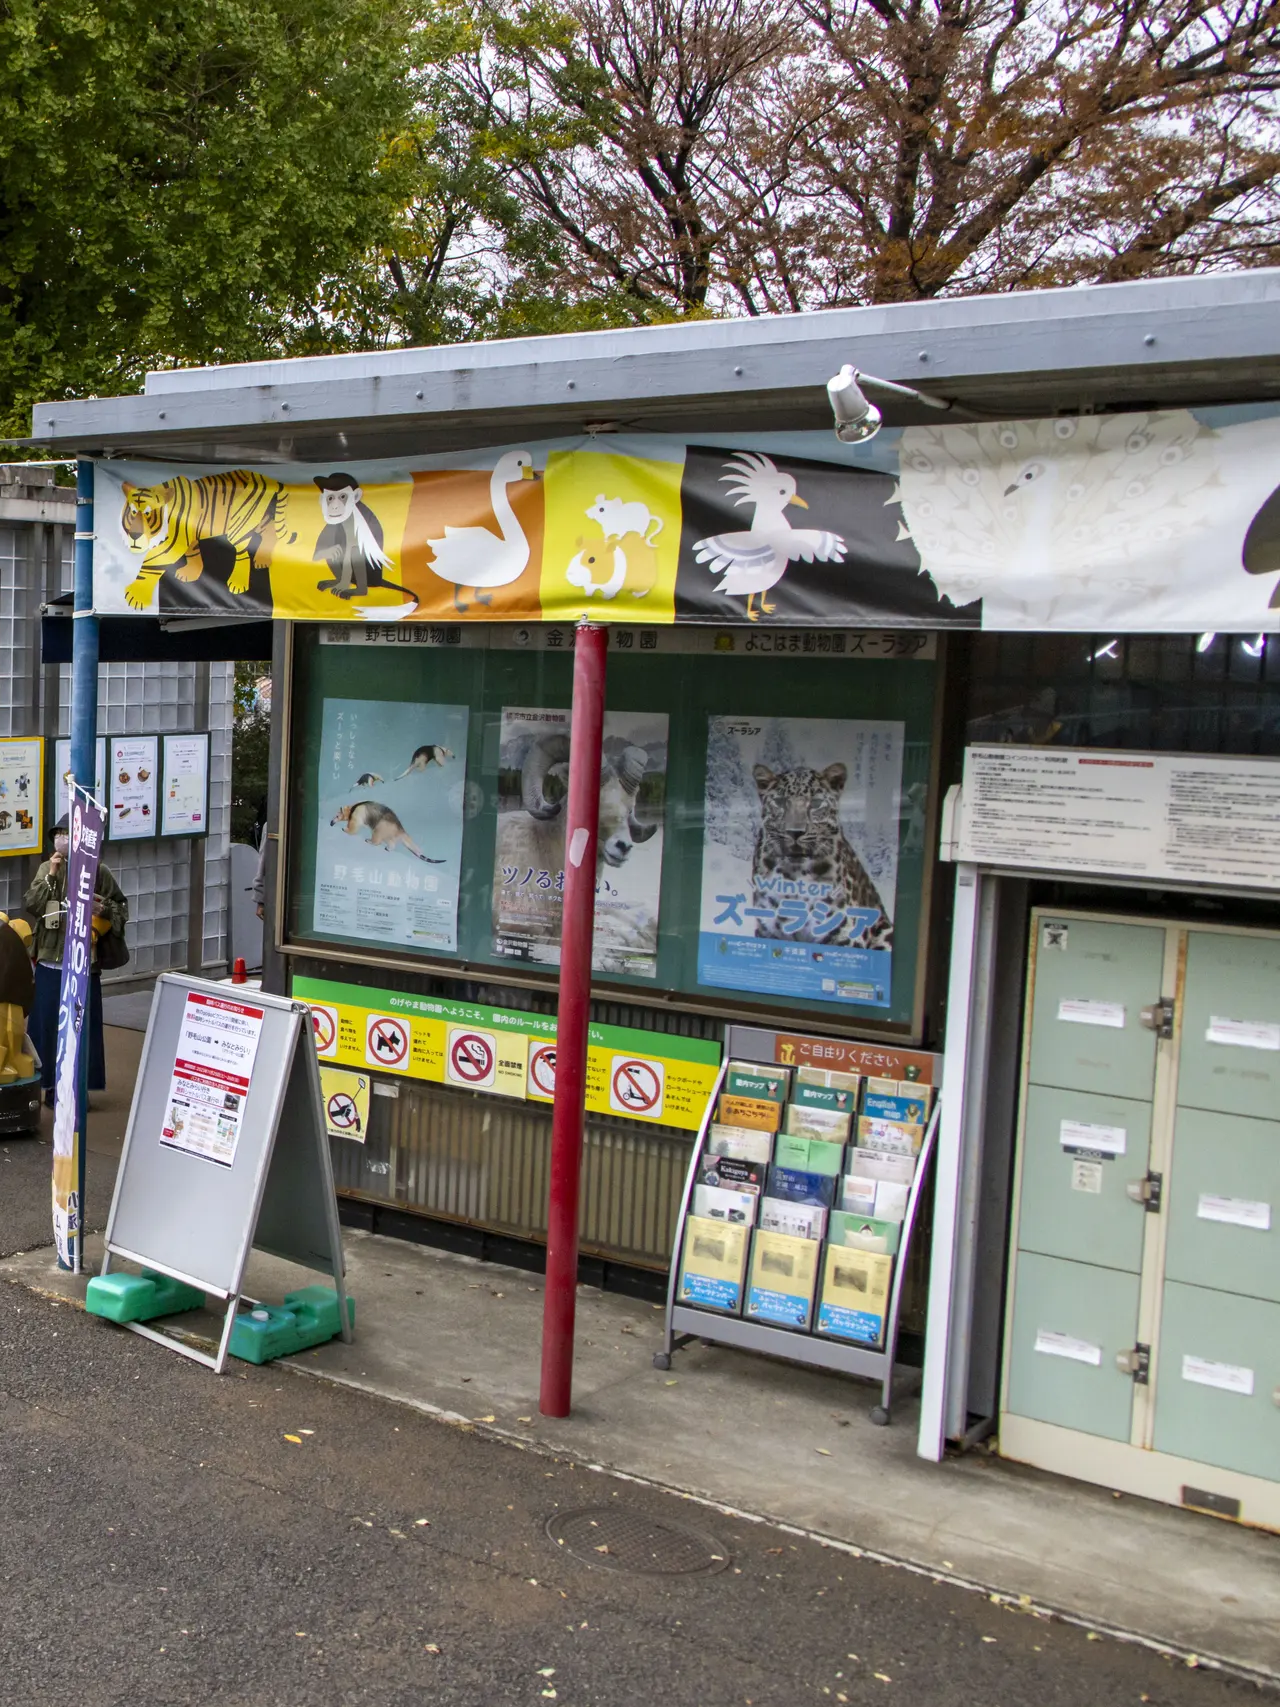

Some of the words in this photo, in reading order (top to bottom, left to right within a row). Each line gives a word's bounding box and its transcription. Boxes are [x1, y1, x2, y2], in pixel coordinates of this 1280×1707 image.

[365, 626, 461, 644] 野毛山動物園
[746, 632, 847, 653] よこはま動物園
[851, 633, 928, 655] ズーラシア
[727, 726, 761, 735] ズーラシア
[332, 712, 344, 780] ズーっと楽しい
[348, 713, 358, 770] いっしょなら
[333, 864, 439, 892] 野毛山動物園
[754, 875, 833, 898] Winter
[713, 893, 882, 939] ズーラシア
[389, 996, 485, 1021] のげやま動物園へようこそ。
[340, 1026, 356, 1035] 食べ物を
[413, 1030, 431, 1038] ペットを
[339, 1043, 362, 1053] いけません。
[413, 1038, 426, 1046] 連れて
[412, 1046, 443, 1057] 園内に入っては
[412, 1056, 437, 1065] いけません。
[498, 1059, 523, 1071] 全面禁煙
[666, 1075, 703, 1086] キックボードや
[735, 1078, 765, 1090] 園内マップ
[665, 1094, 691, 1103] あそんでは
[803, 1089, 835, 1101] 園内マップ
[665, 1103, 693, 1113] いけません。
[867, 1098, 897, 1110] English
[883, 1110, 901, 1119] map
